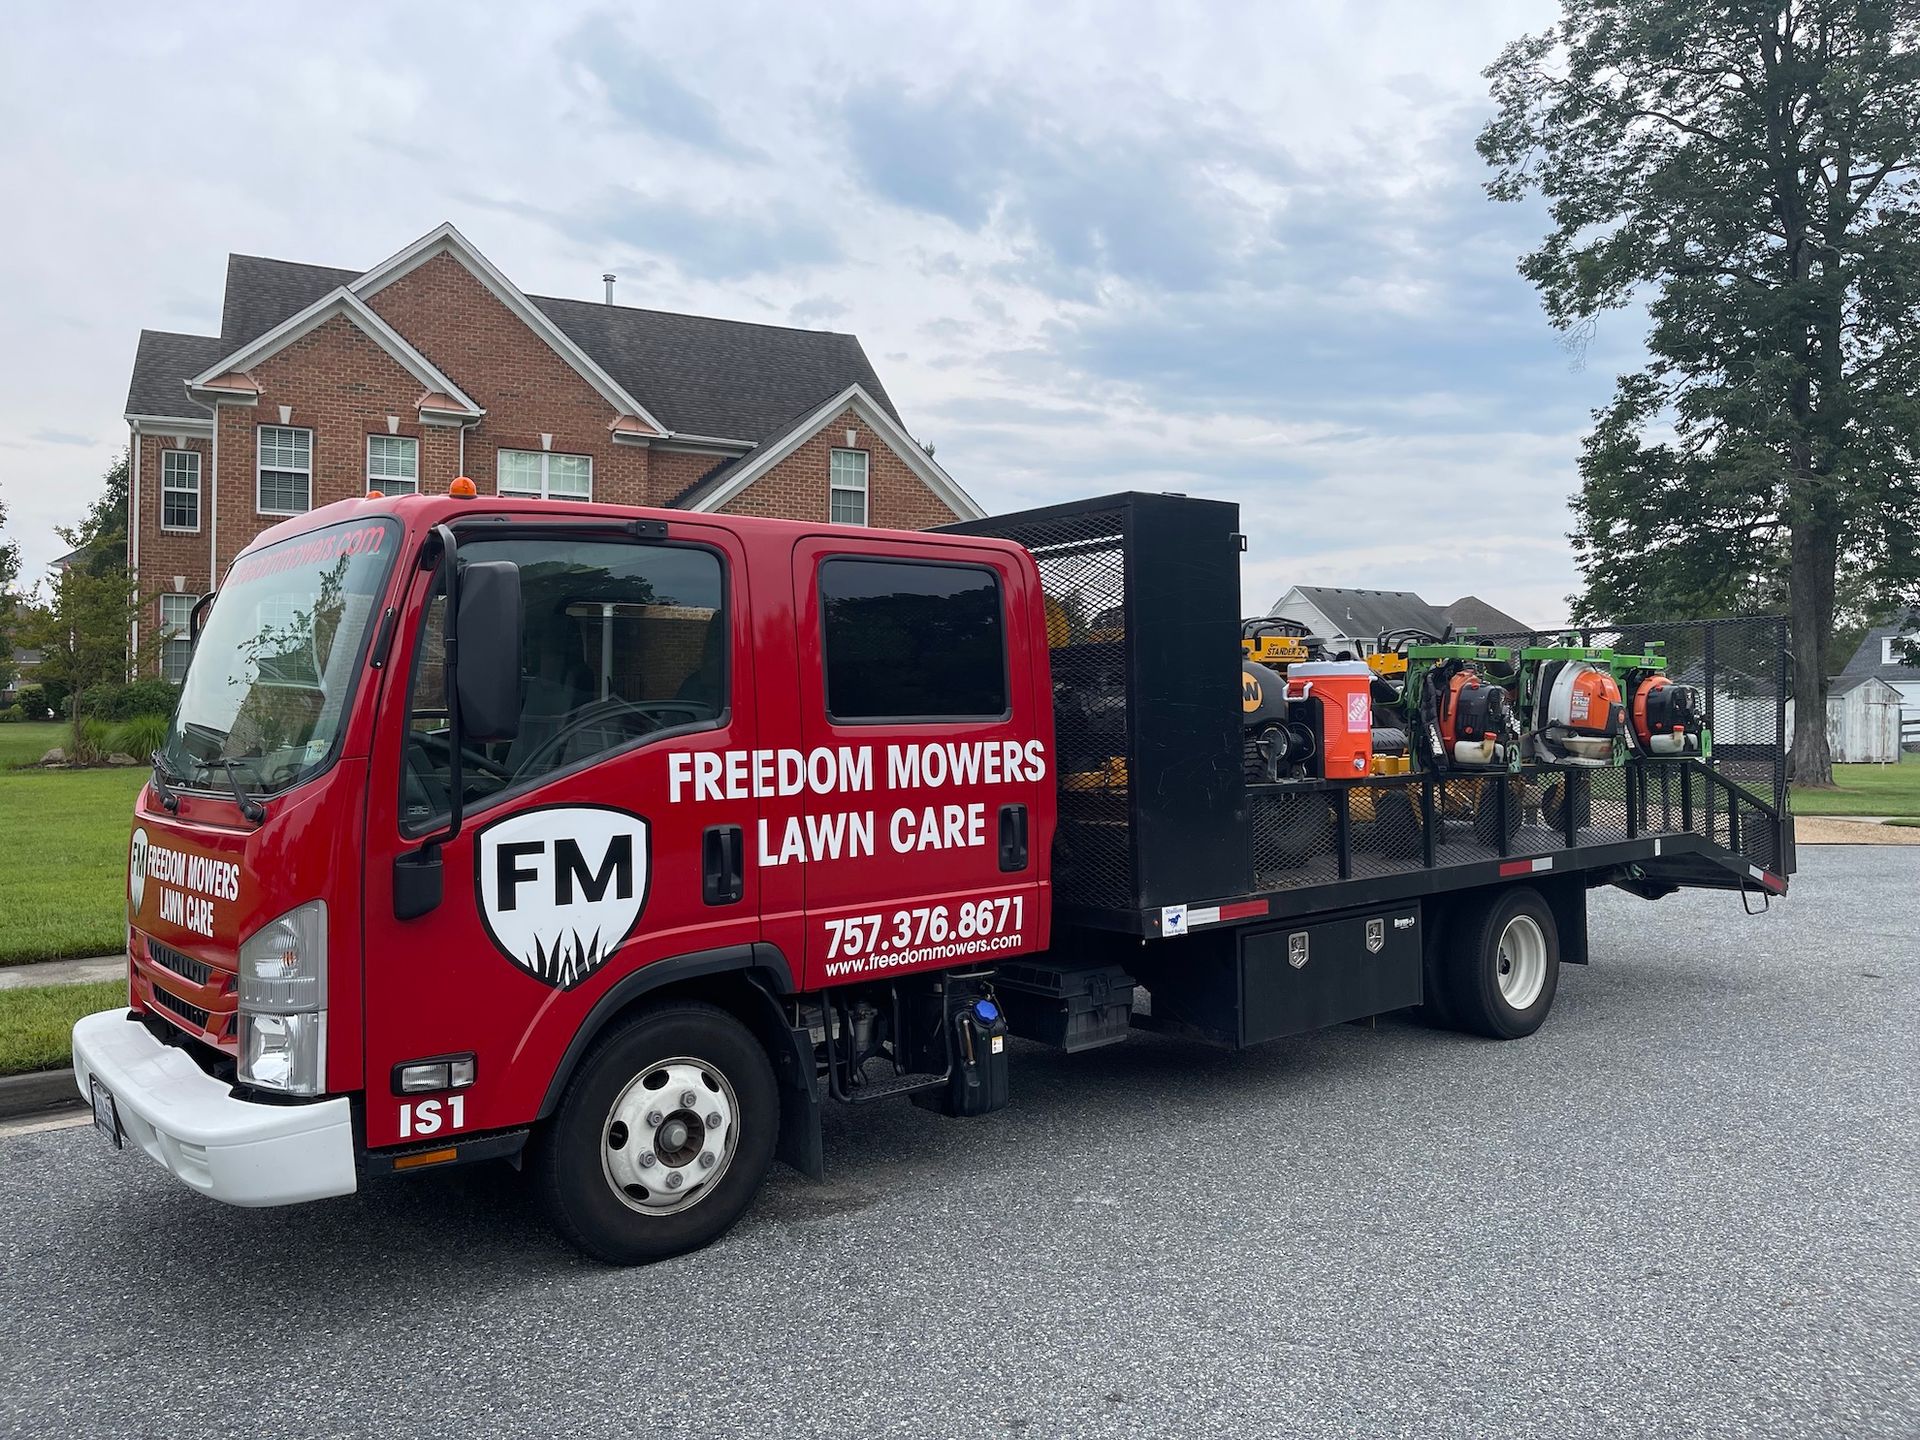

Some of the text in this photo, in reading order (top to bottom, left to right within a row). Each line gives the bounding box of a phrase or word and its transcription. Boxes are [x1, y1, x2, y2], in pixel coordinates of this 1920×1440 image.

[668, 739, 1047, 803] FREEDOM MOWERS
[757, 802, 986, 867] LAWN CARE
[147, 844, 240, 902] FREEDOM MOWERS
[496, 834, 633, 912] FM
[160, 886, 214, 938] LAWN CARE
[825, 895, 1024, 959] 757.376.8671
[825, 933, 1022, 977] www.freedommowers.com
[399, 1095, 464, 1138] IS1
